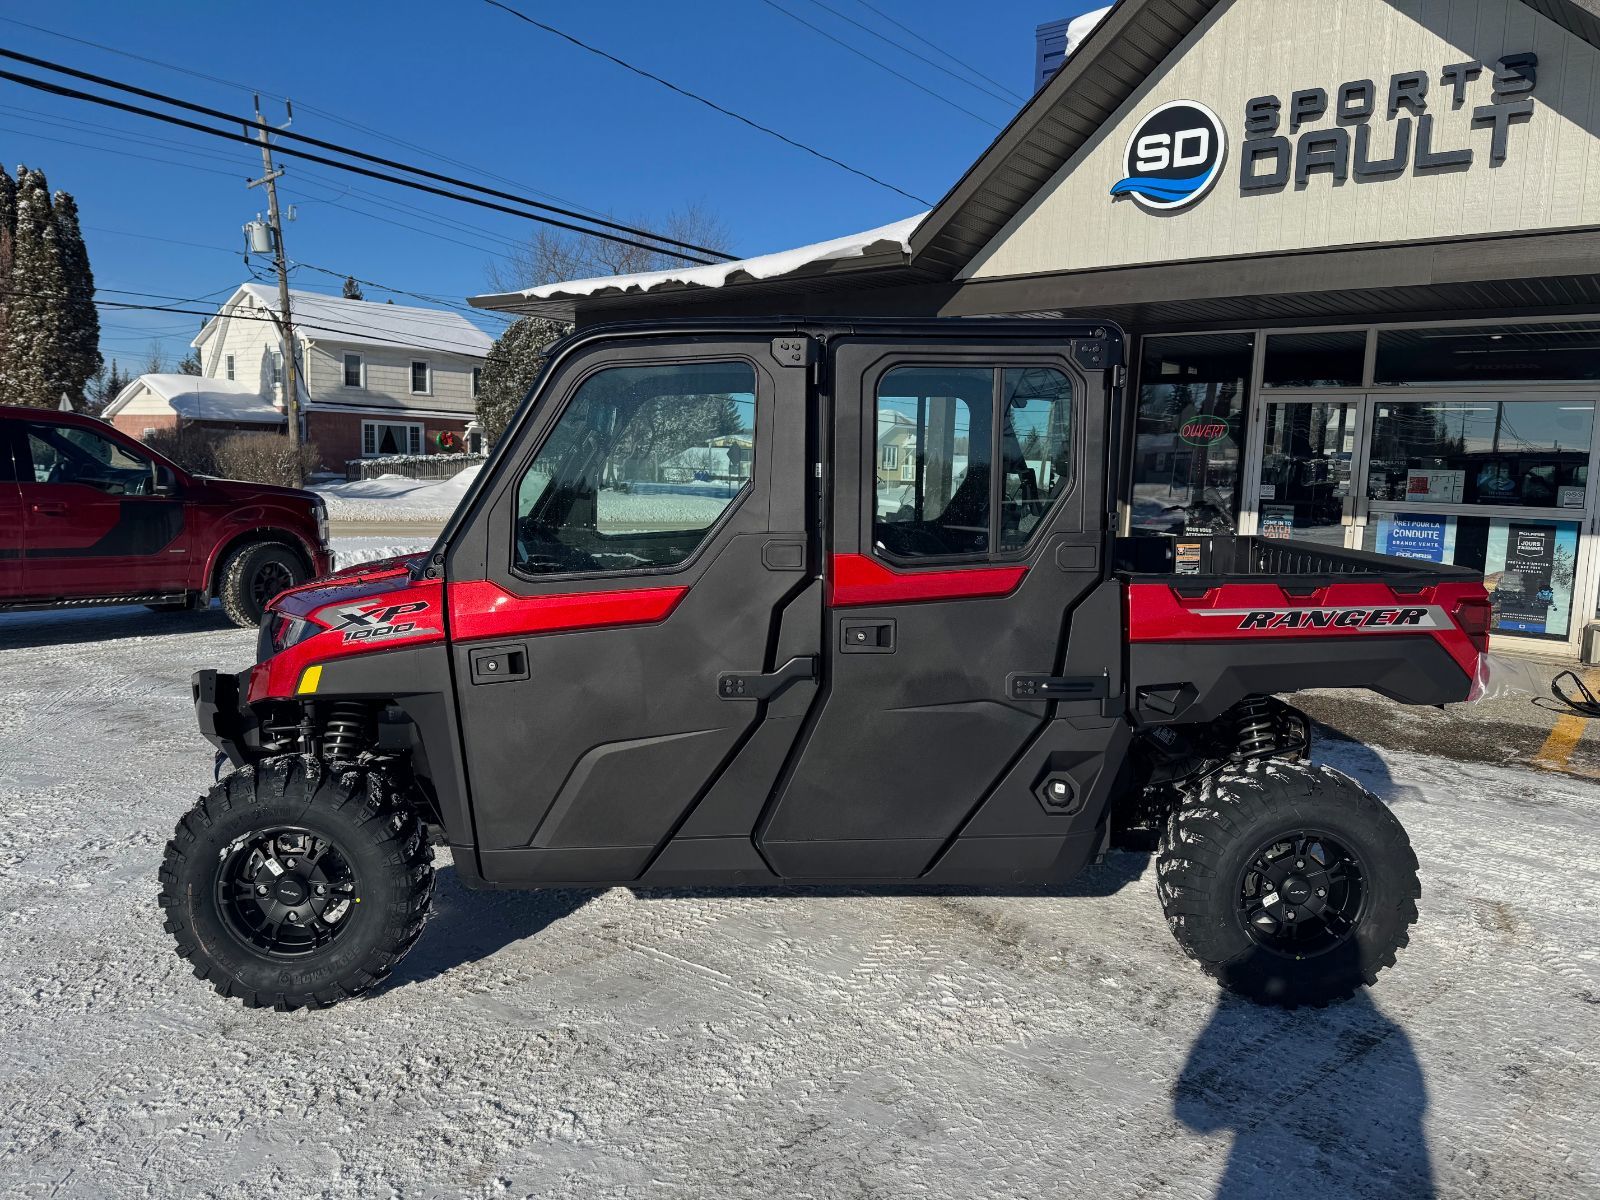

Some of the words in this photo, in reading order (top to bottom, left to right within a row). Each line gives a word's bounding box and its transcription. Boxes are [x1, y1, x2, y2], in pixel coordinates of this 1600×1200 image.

[1245, 51, 1538, 133] SPORTS
[1136, 127, 1209, 172] SD
[1239, 99, 1534, 191] DAULT
[1182, 424, 1226, 438] OUVERT
[1263, 525, 1291, 534] CATCH
[1393, 529, 1440, 540] CONDUITE
[1395, 551, 1432, 559] POLARIS
[325, 601, 430, 633] XP
[1237, 607, 1429, 630] RANGER
[342, 621, 416, 643] 1000
